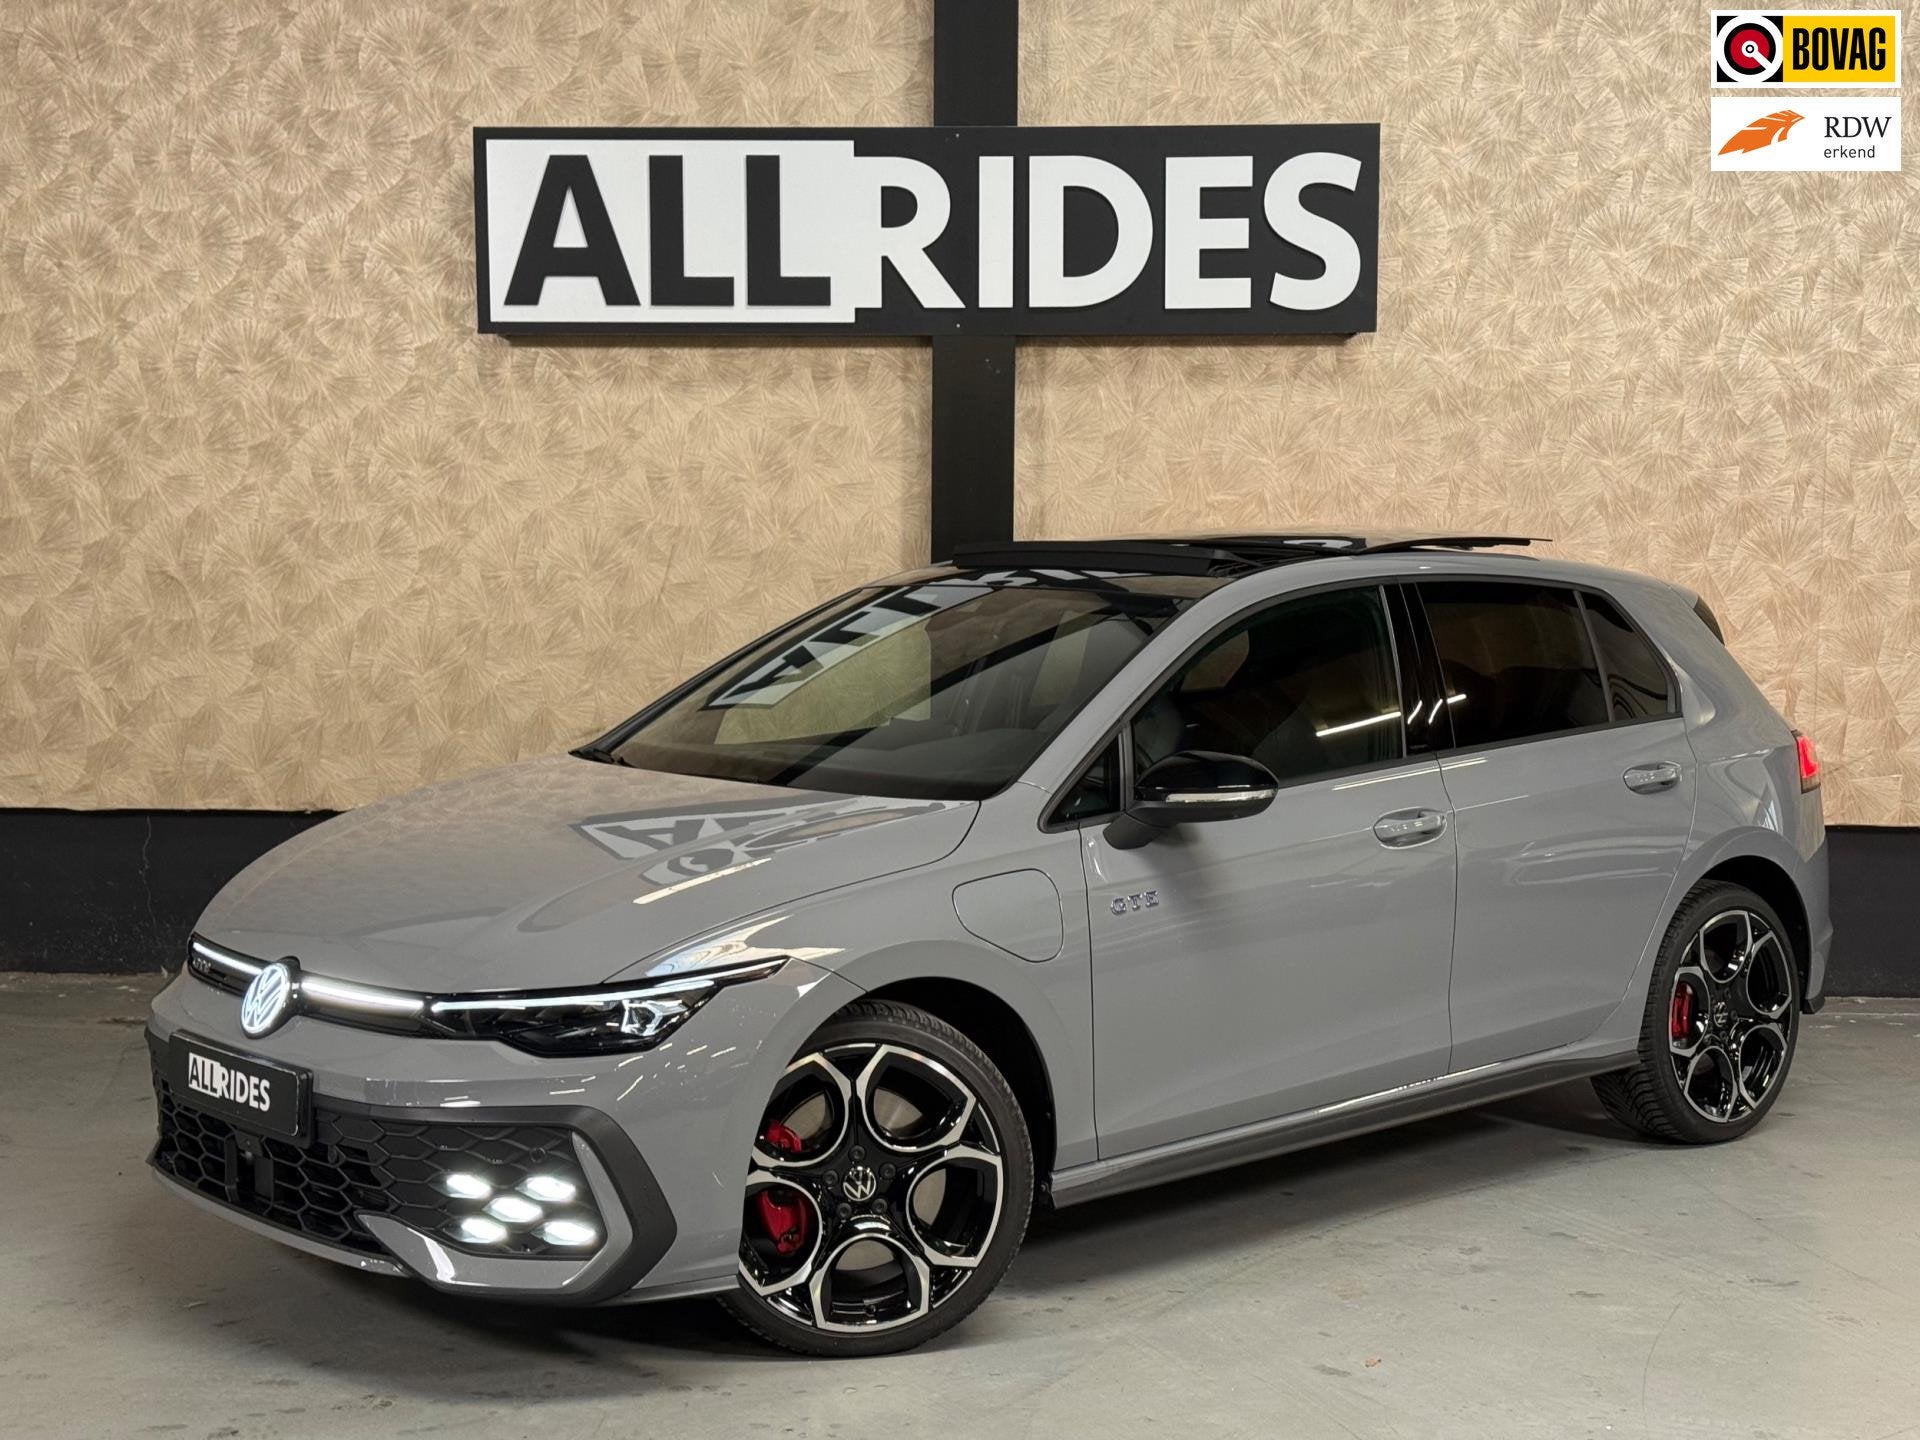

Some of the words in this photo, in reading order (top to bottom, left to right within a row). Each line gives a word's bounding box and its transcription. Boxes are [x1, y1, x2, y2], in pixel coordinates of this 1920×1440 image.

[503, 151, 1363, 311] ALLRIDES
[1111, 890, 1160, 915] GTE
[189, 1054, 271, 1112] ALLRIDES
